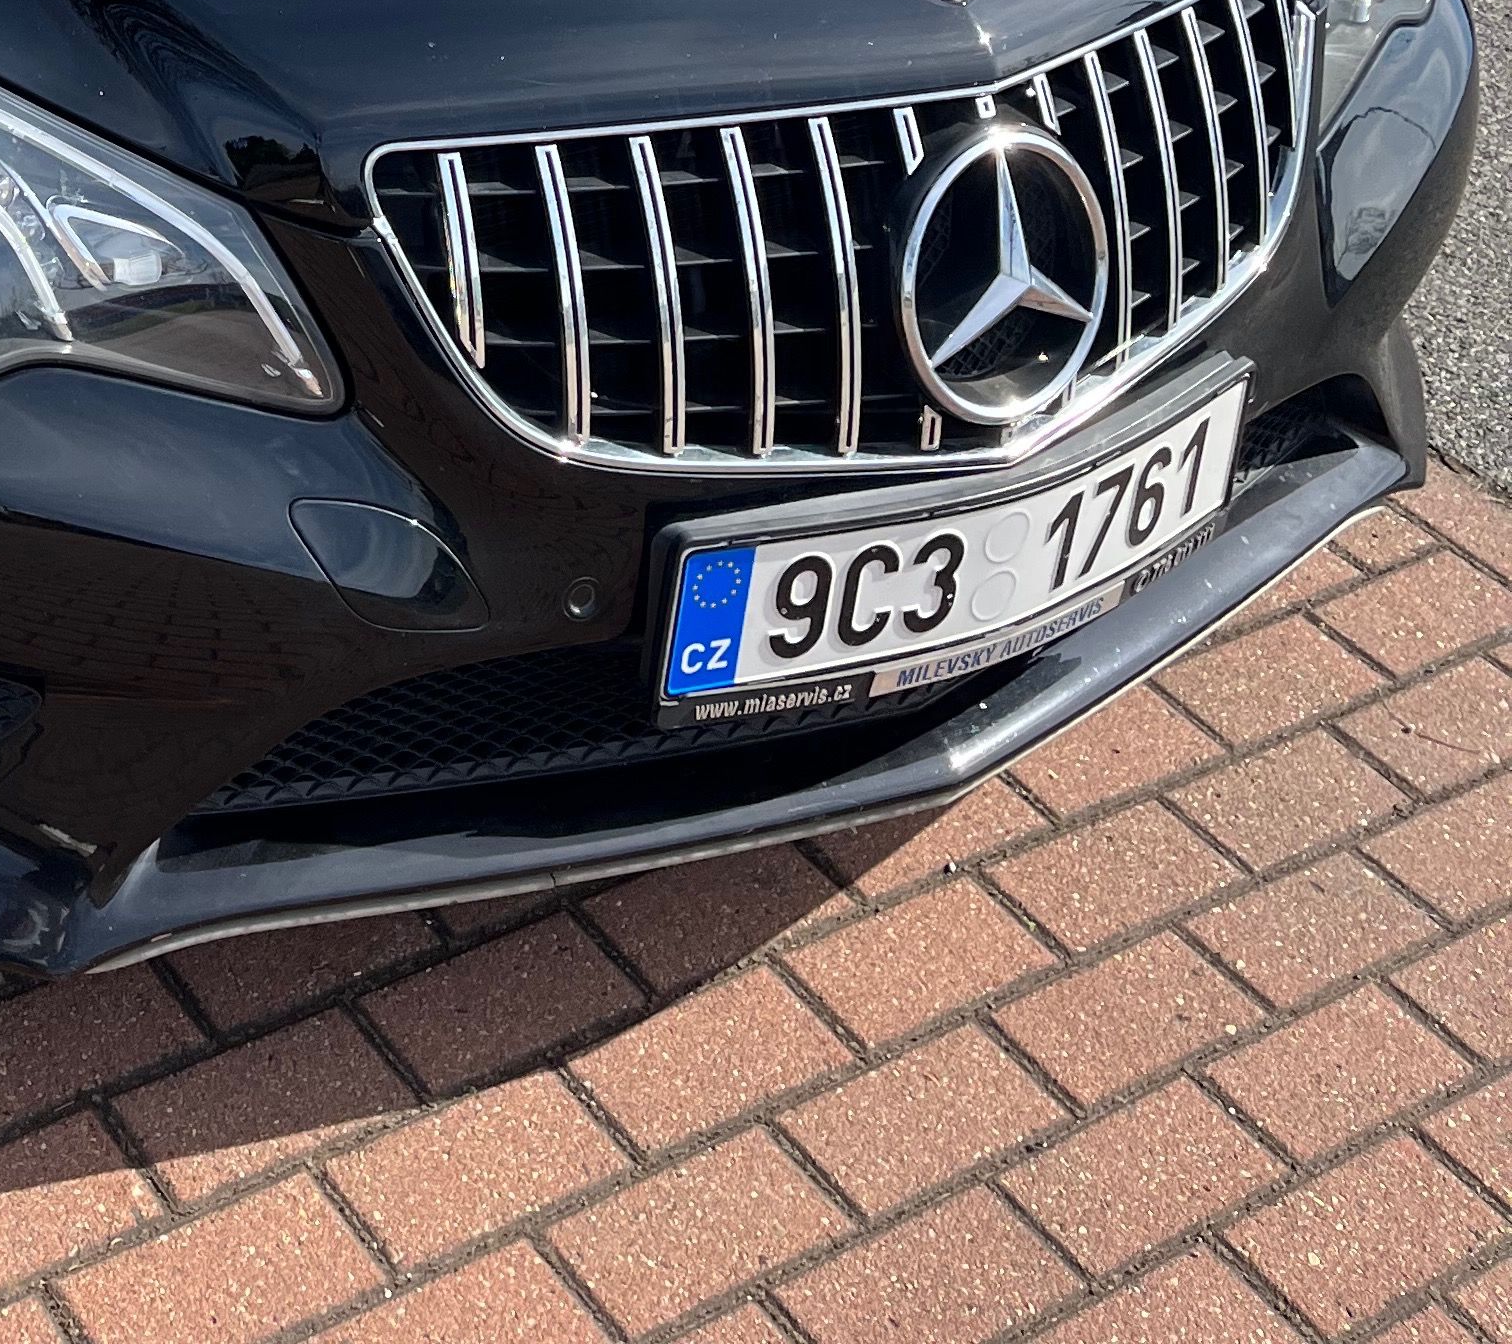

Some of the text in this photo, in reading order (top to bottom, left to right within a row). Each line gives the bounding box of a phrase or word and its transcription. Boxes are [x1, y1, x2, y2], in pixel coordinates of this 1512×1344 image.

[769, 533, 965, 660] 9C3
[1048, 416, 1212, 591] 1761
[680, 637, 732, 675] CZ
[999, 596, 1105, 660] AUTOSERVIS
